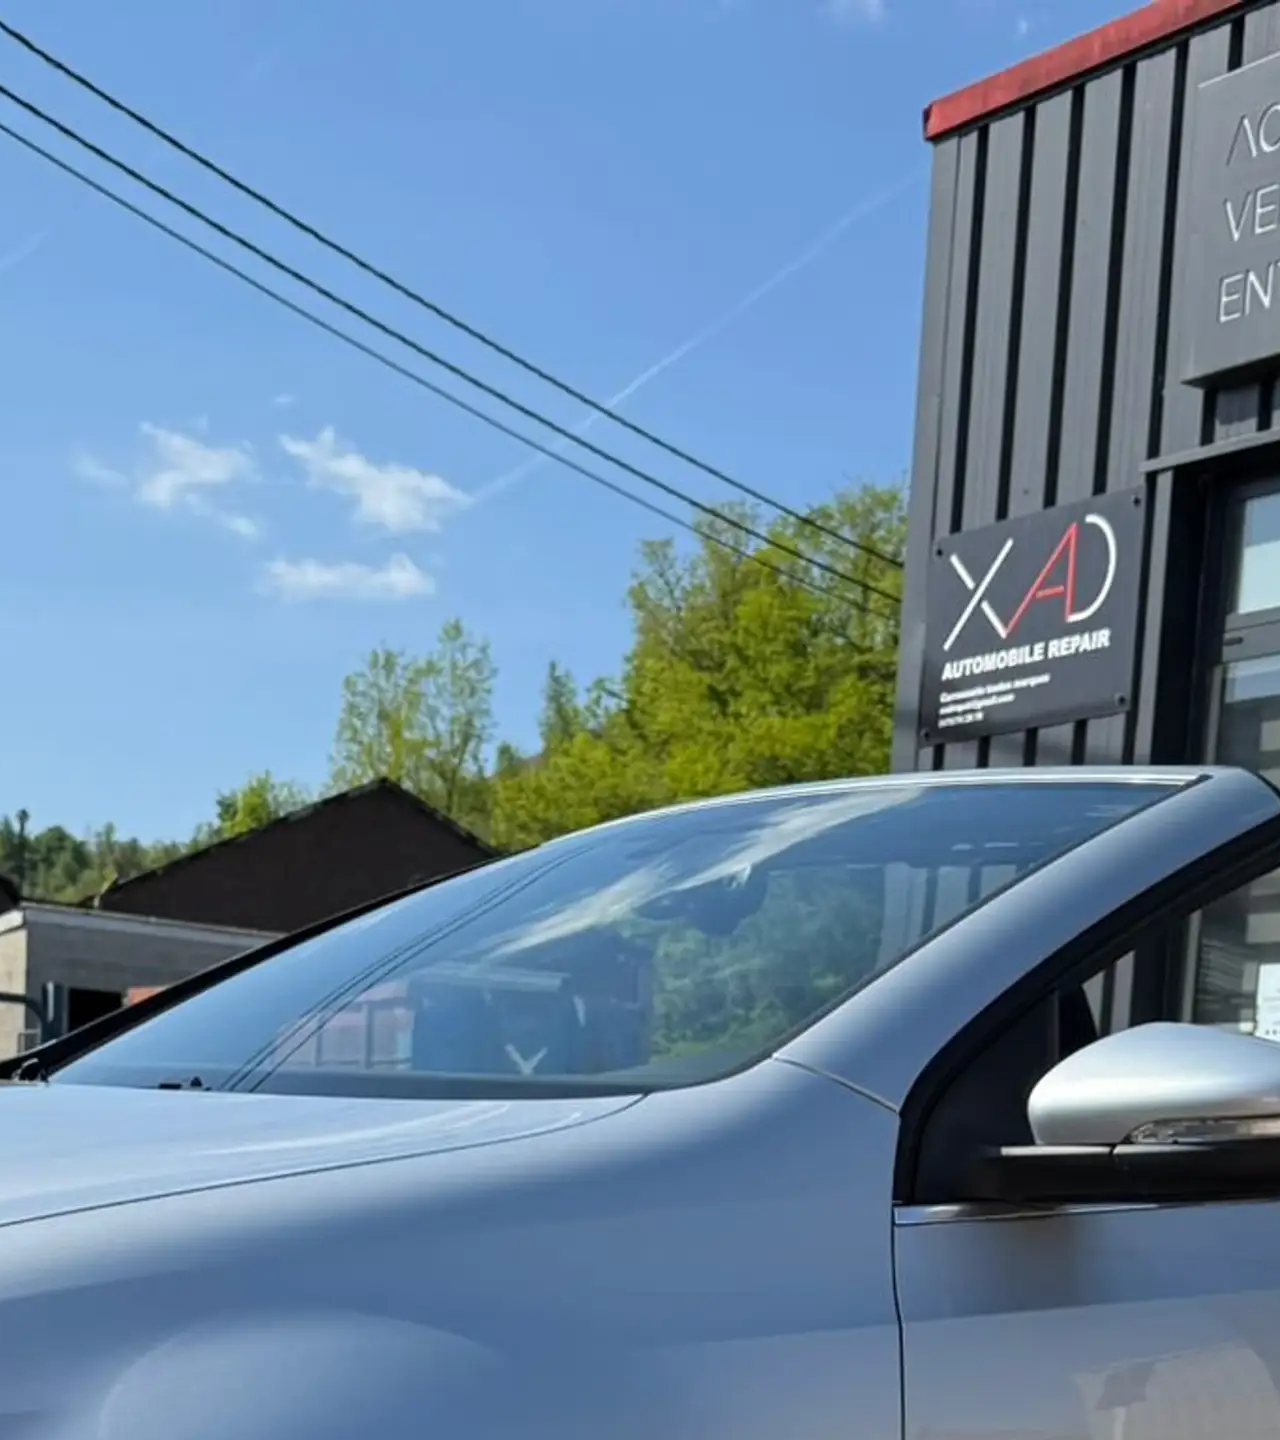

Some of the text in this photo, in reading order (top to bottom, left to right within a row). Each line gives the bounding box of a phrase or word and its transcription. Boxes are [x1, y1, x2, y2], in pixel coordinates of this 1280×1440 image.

[942, 512, 1117, 651] XAD
[941, 626, 1112, 682] AUTOMOBILE REPAIR
